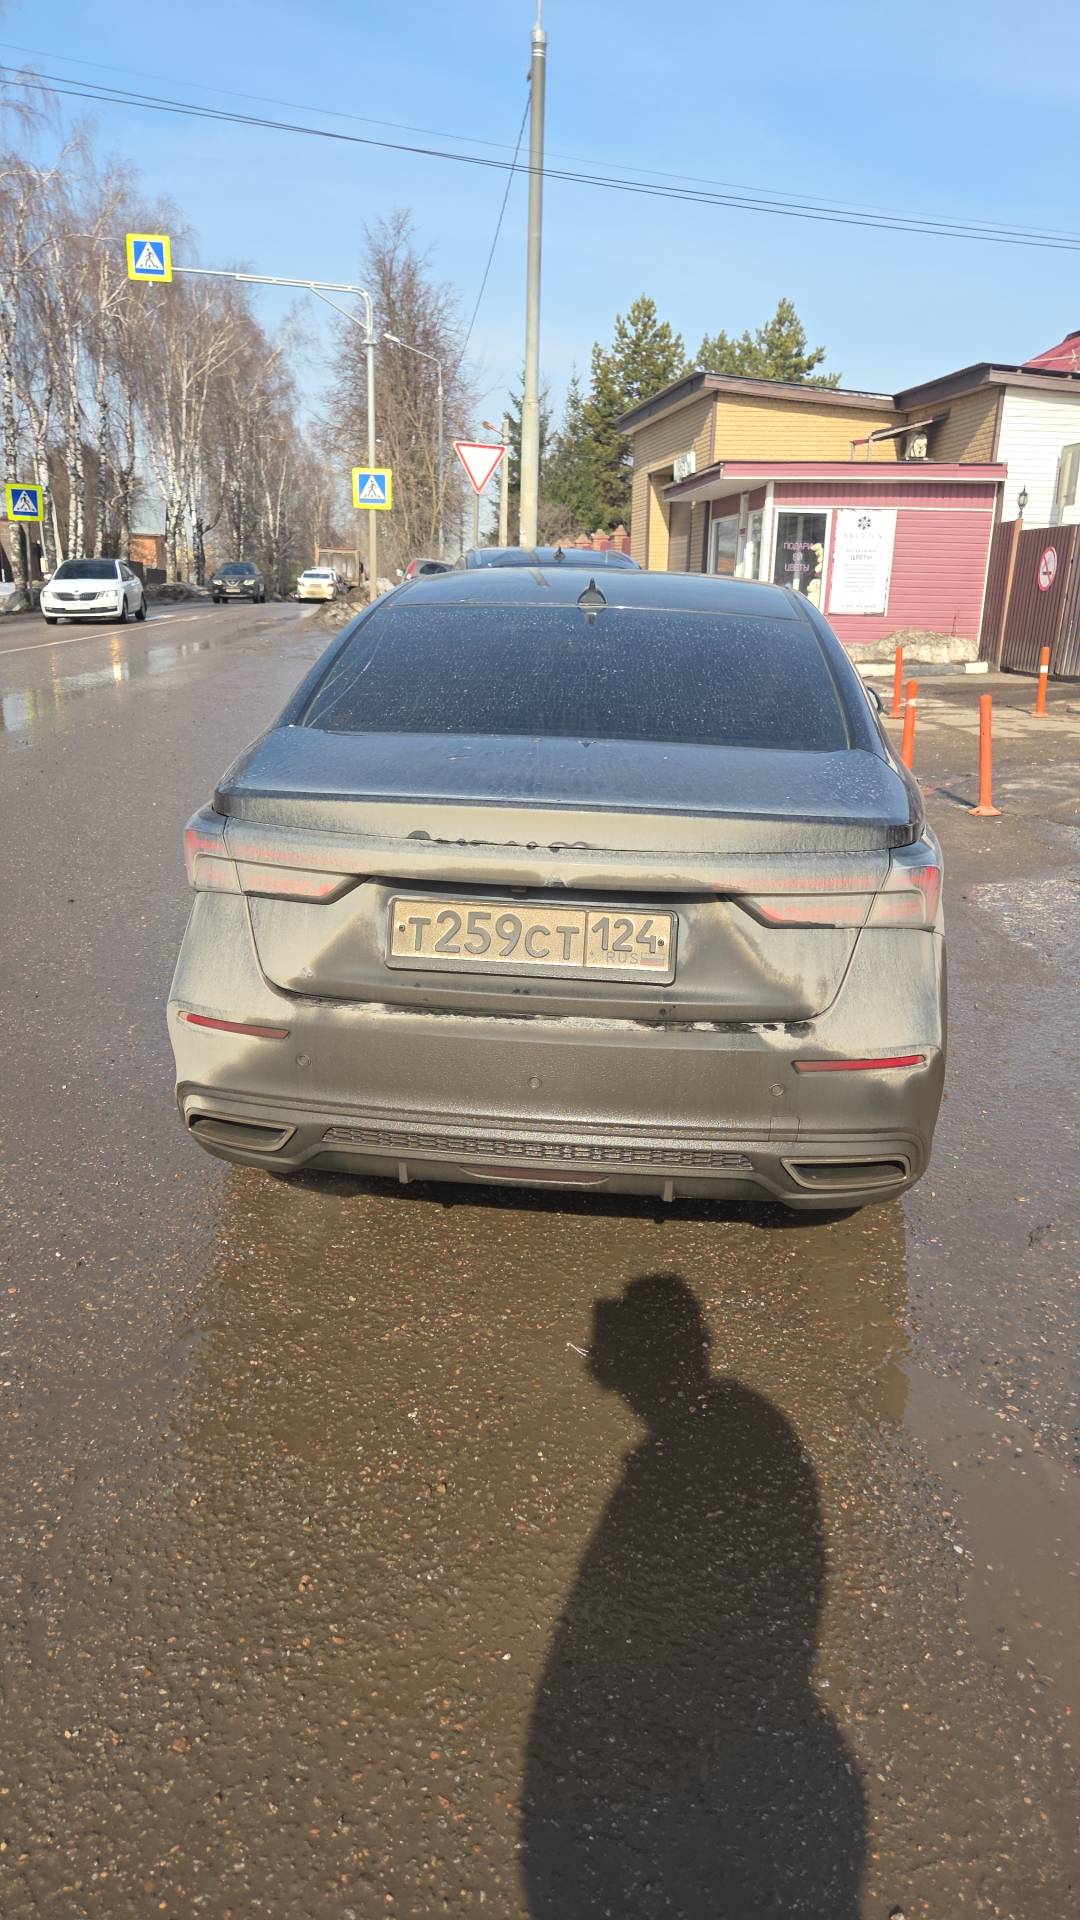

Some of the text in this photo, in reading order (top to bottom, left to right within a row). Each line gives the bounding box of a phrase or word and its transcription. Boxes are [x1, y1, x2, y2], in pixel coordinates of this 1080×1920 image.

[784, 563, 810, 572] ЦВЕТЫ
[591, 916, 657, 954] 124
[606, 951, 639, 964] RUS
